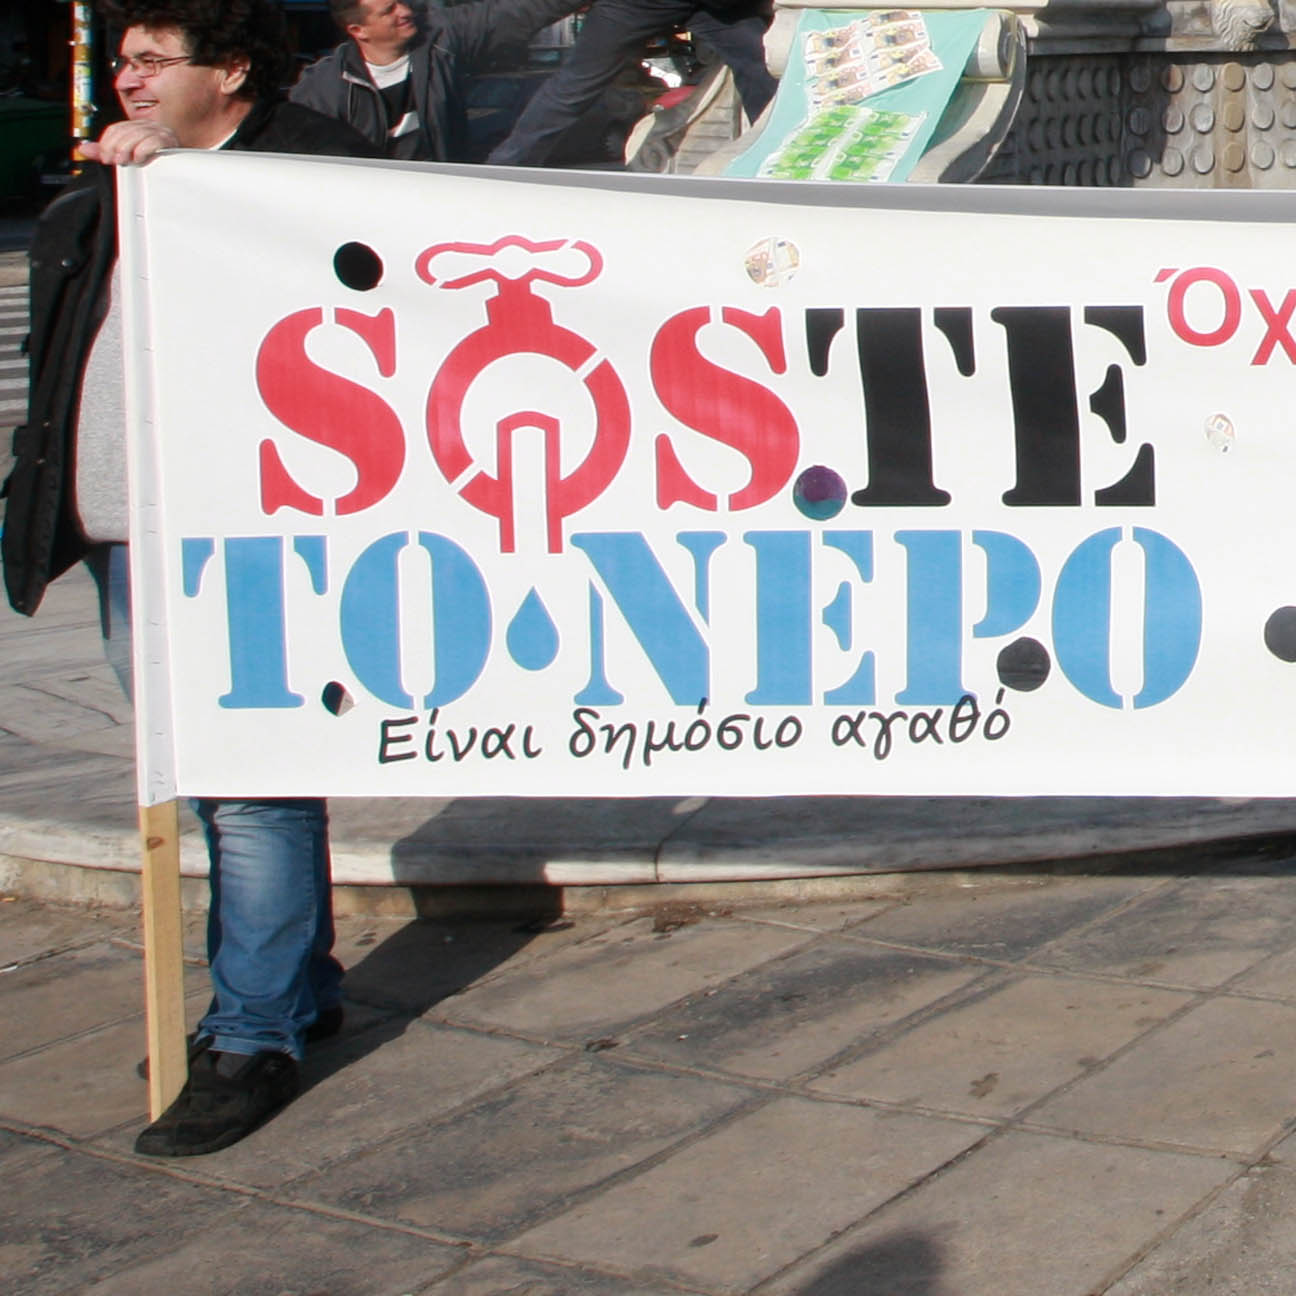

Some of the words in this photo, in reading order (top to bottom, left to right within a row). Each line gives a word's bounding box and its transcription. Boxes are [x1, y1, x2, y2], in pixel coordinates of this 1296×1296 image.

[570, 526, 1203, 710] ΝΕΡΟ
[378, 708, 541, 764] Είναι
[569, 697, 802, 769] δημόσιο
[832, 688, 1010, 760] αγαθό
